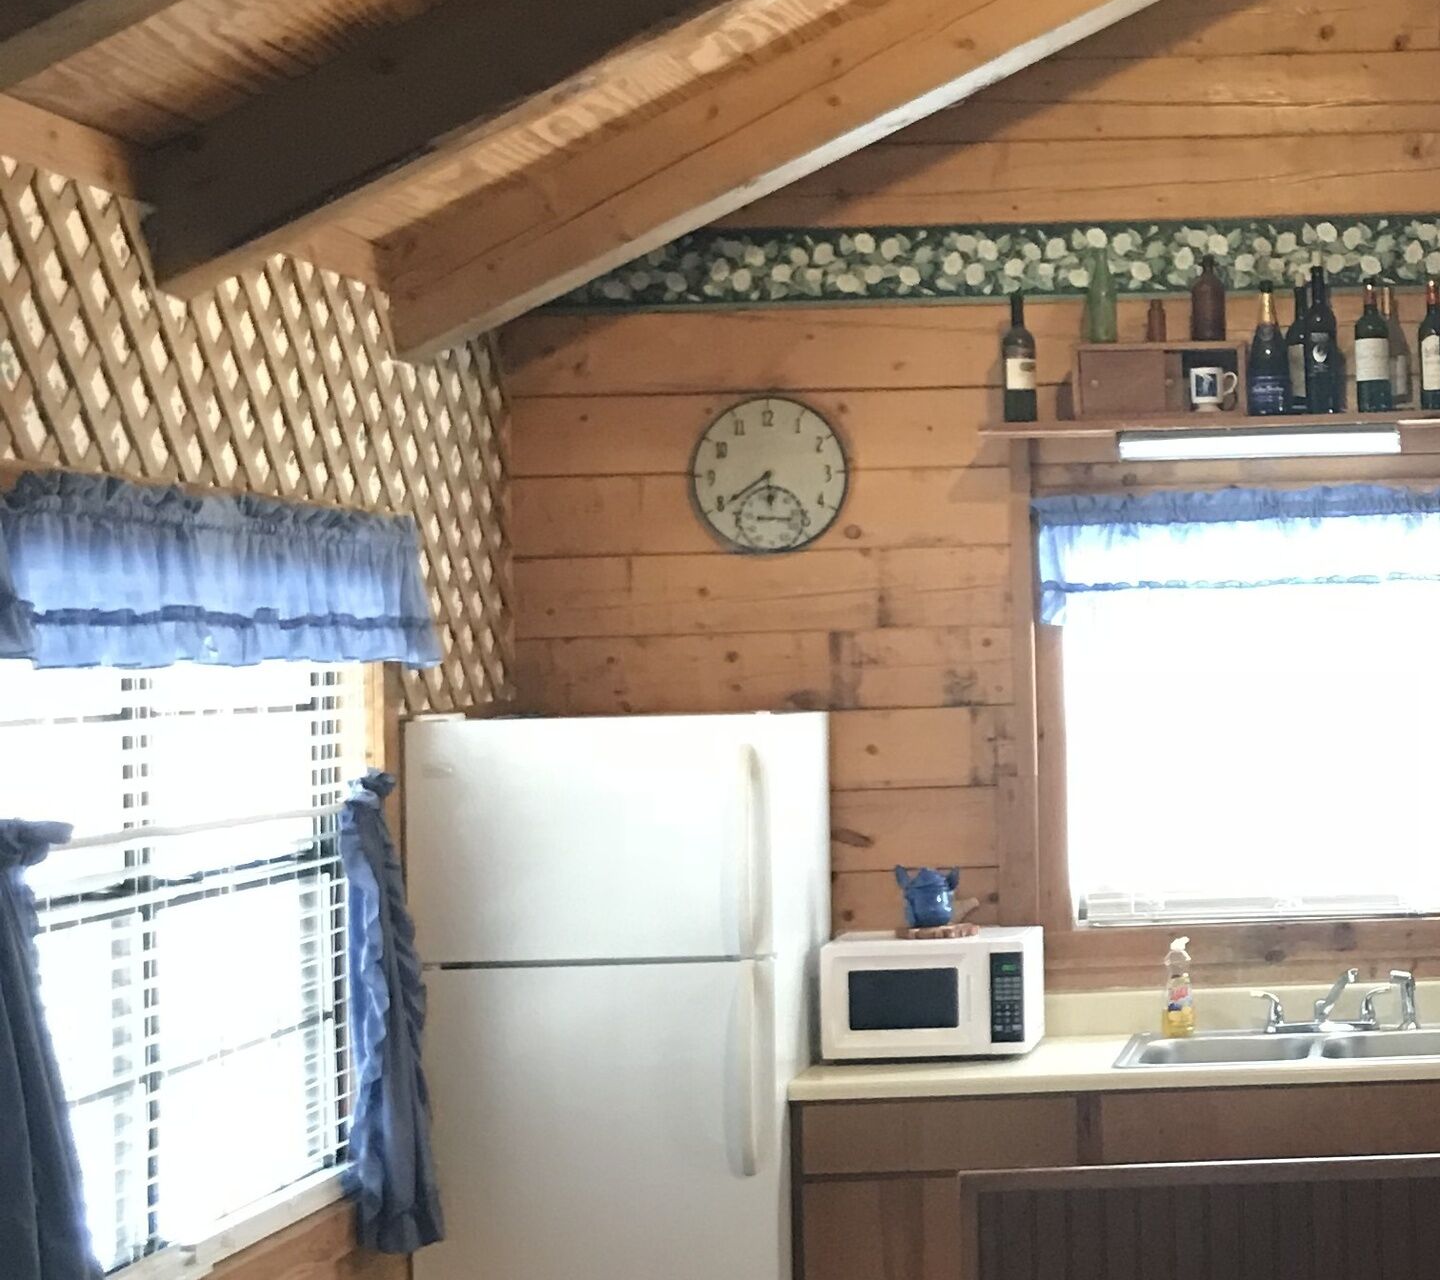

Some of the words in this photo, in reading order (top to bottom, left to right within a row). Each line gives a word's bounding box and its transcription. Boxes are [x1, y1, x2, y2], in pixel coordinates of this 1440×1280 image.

[761, 410, 774, 427] 12
[794, 418, 801, 434] 1
[734, 420, 746, 436] 11
[715, 441, 728, 459] 10
[815, 436, 824, 453] 2
[706, 469, 716, 486] 9
[824, 465, 833, 482] 3
[716, 495, 725, 512] 8
[816, 492, 825, 508] 4
